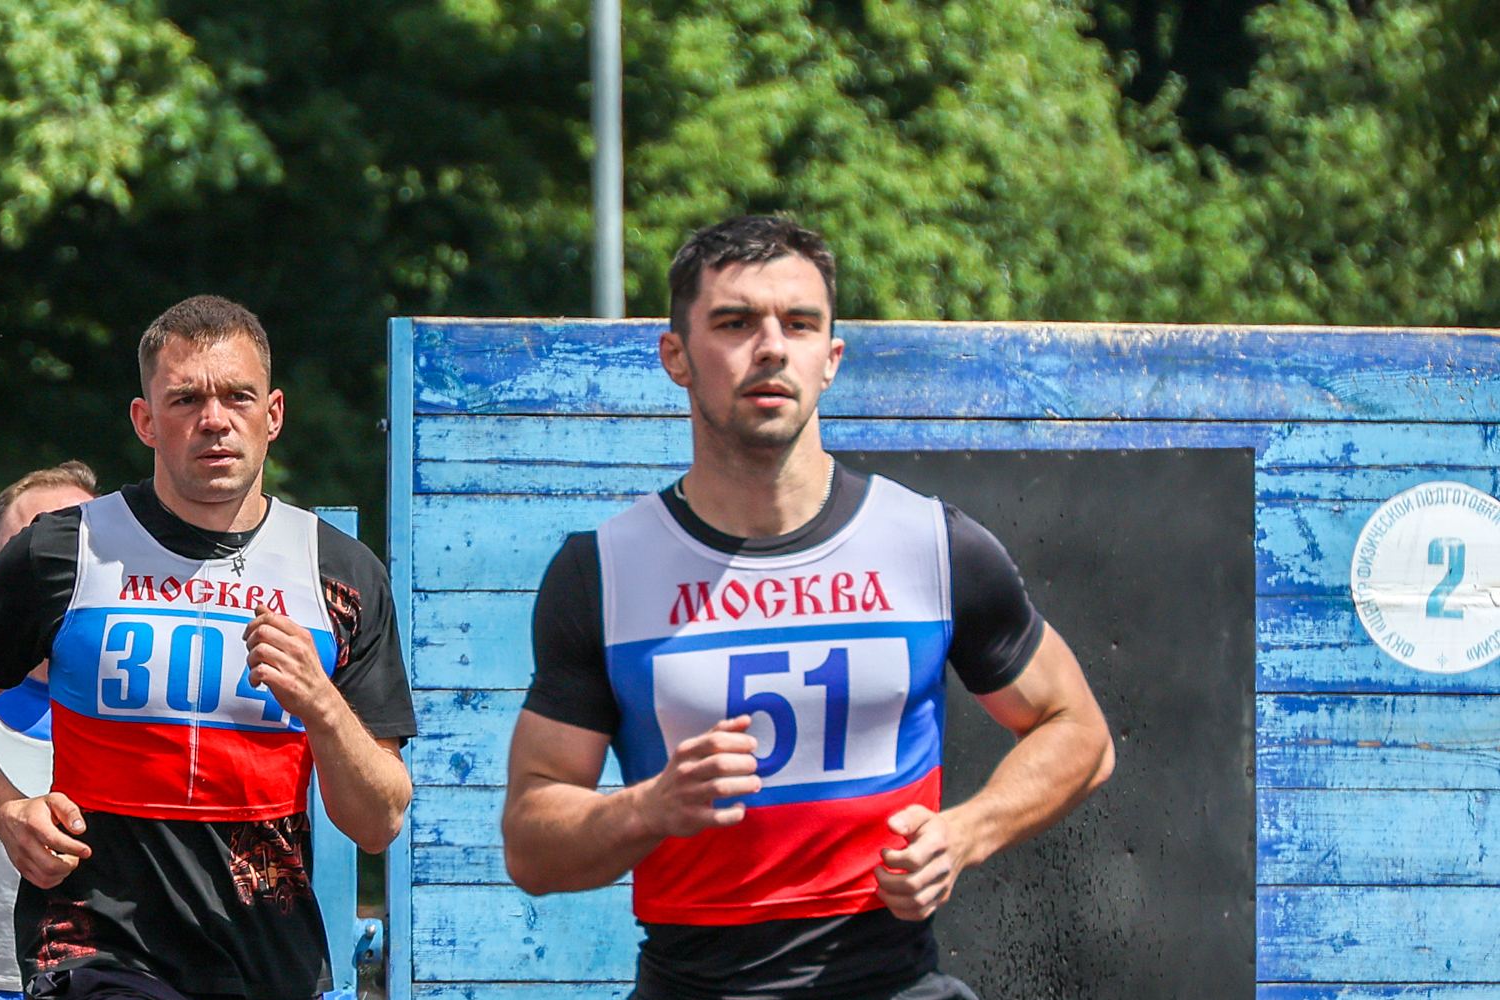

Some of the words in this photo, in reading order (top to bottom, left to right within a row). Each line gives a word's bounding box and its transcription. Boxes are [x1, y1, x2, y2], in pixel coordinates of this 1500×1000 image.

[119, 575, 290, 617] МОСКВА
[669, 571, 894, 626] МОСКВА
[1426, 537, 1465, 618] 2
[726, 647, 850, 778] 51
